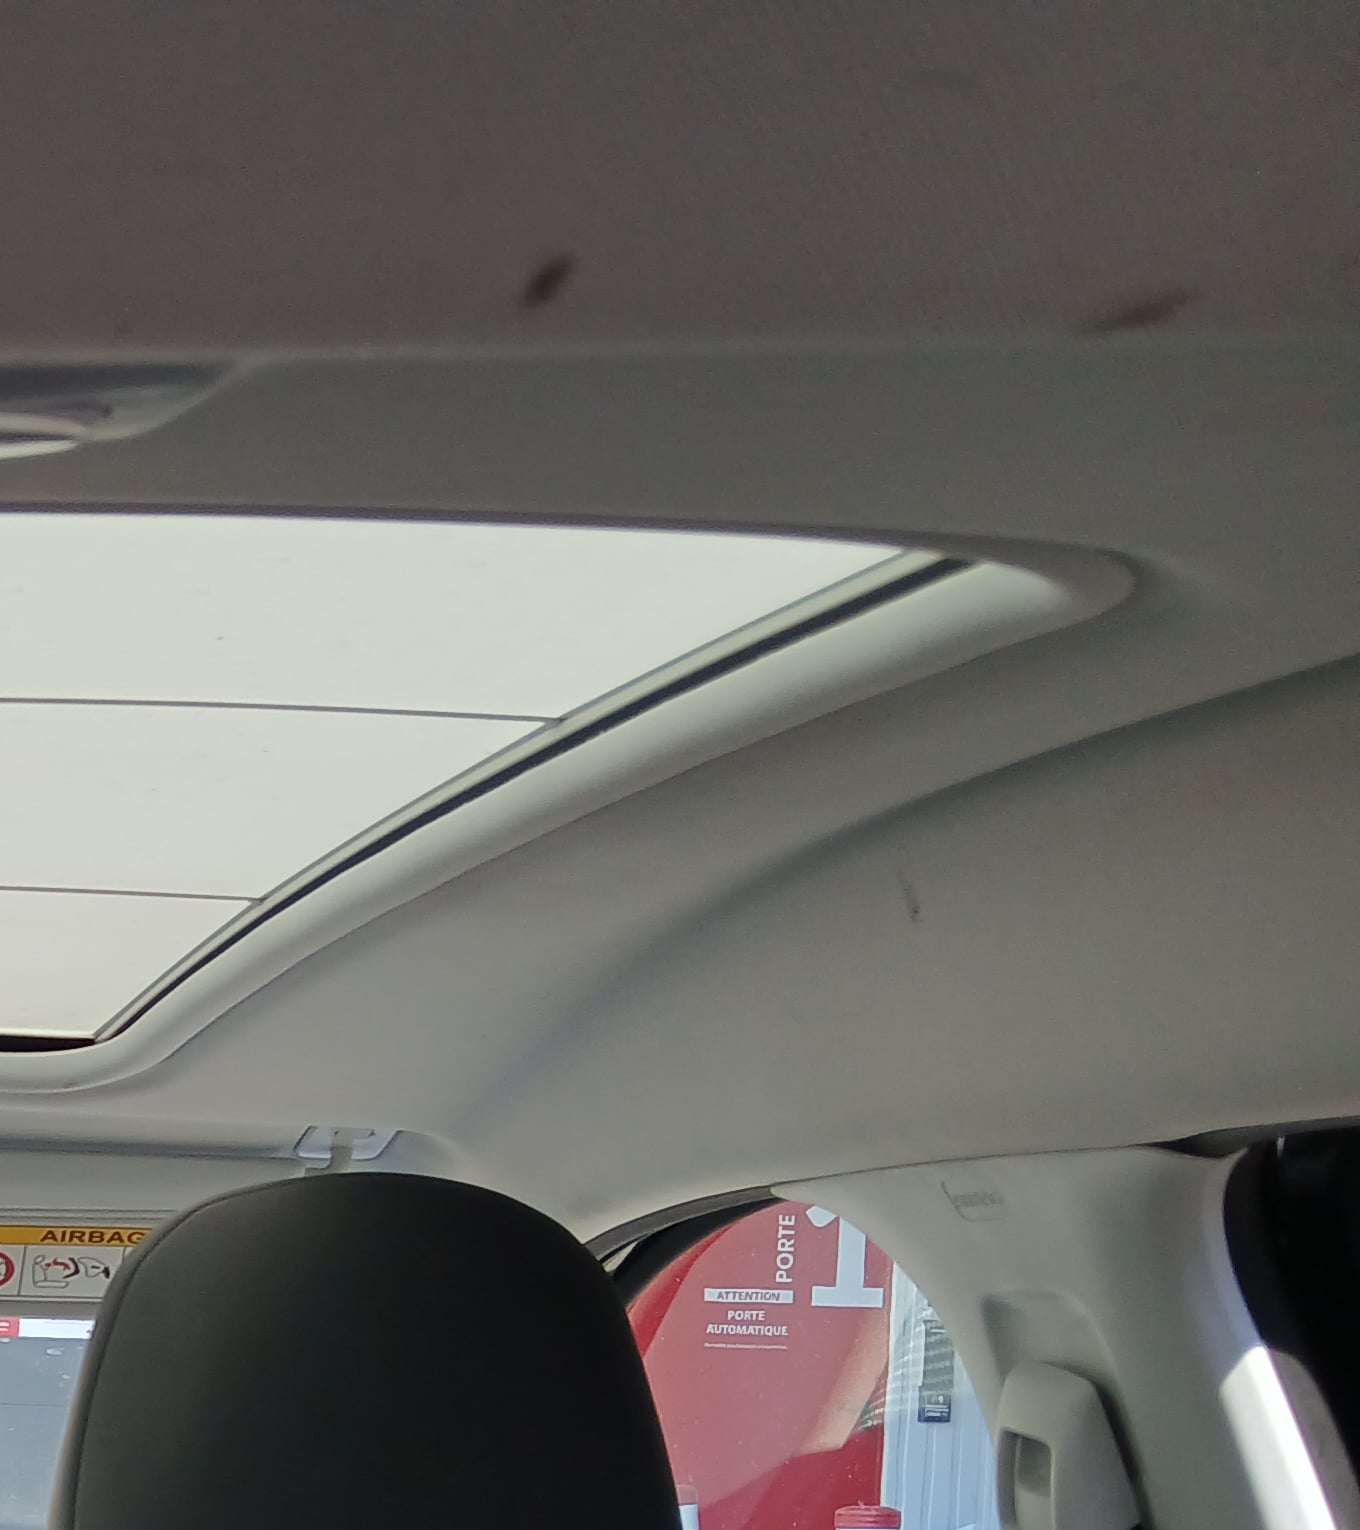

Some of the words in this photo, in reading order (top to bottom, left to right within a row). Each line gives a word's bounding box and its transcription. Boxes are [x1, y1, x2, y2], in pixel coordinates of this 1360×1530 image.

[776, 1214, 796, 1283] PORTE
[717, 1290, 781, 1302] ATTENTION
[727, 1310, 766, 1321] PORTE
[705, 1324, 789, 1337] AUTOMATIQUE
